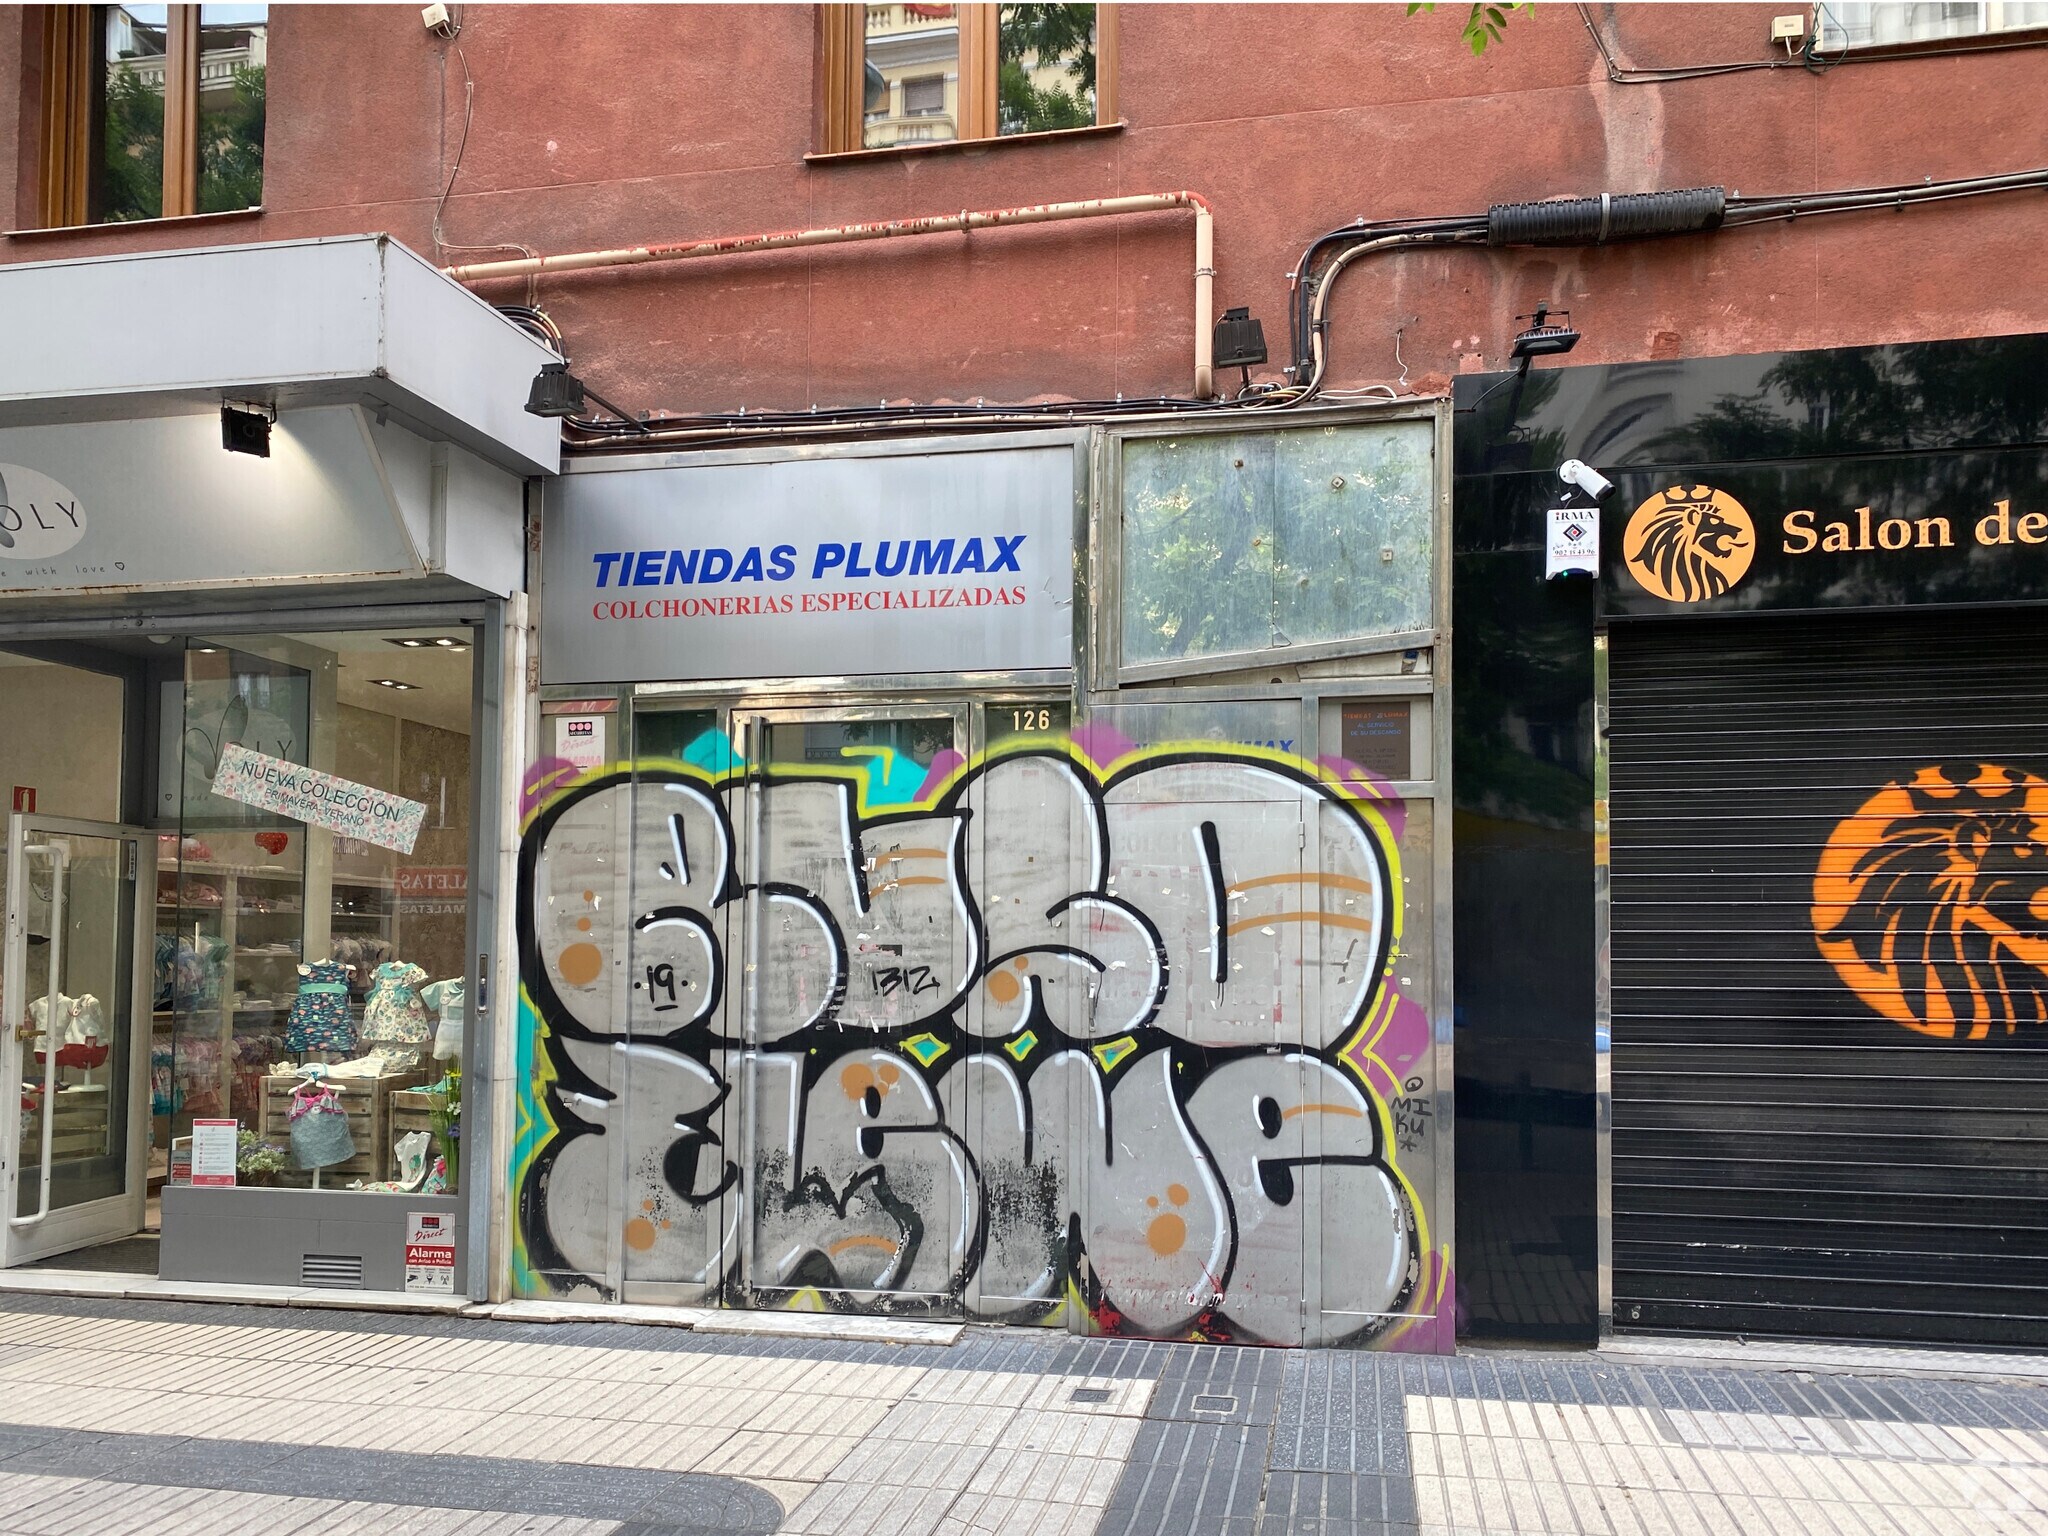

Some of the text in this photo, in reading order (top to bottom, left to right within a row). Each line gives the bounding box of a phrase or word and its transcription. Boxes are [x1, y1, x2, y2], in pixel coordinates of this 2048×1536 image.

[1782, 499, 2048, 554] Salon de
[25, 565, 105, 576] with love
[592, 535, 1028, 588] TIENDAS PLUMAX
[592, 585, 1026, 621] COLCHONERIAS ESPECIALIZADAS
[1012, 710, 1051, 732] 126
[241, 761, 400, 822] NUEVA COLECCIÓN
[324, 807, 365, 827] VERANO
[414, 1228, 447, 1242] Direct
[409, 1247, 452, 1259] Alarma
